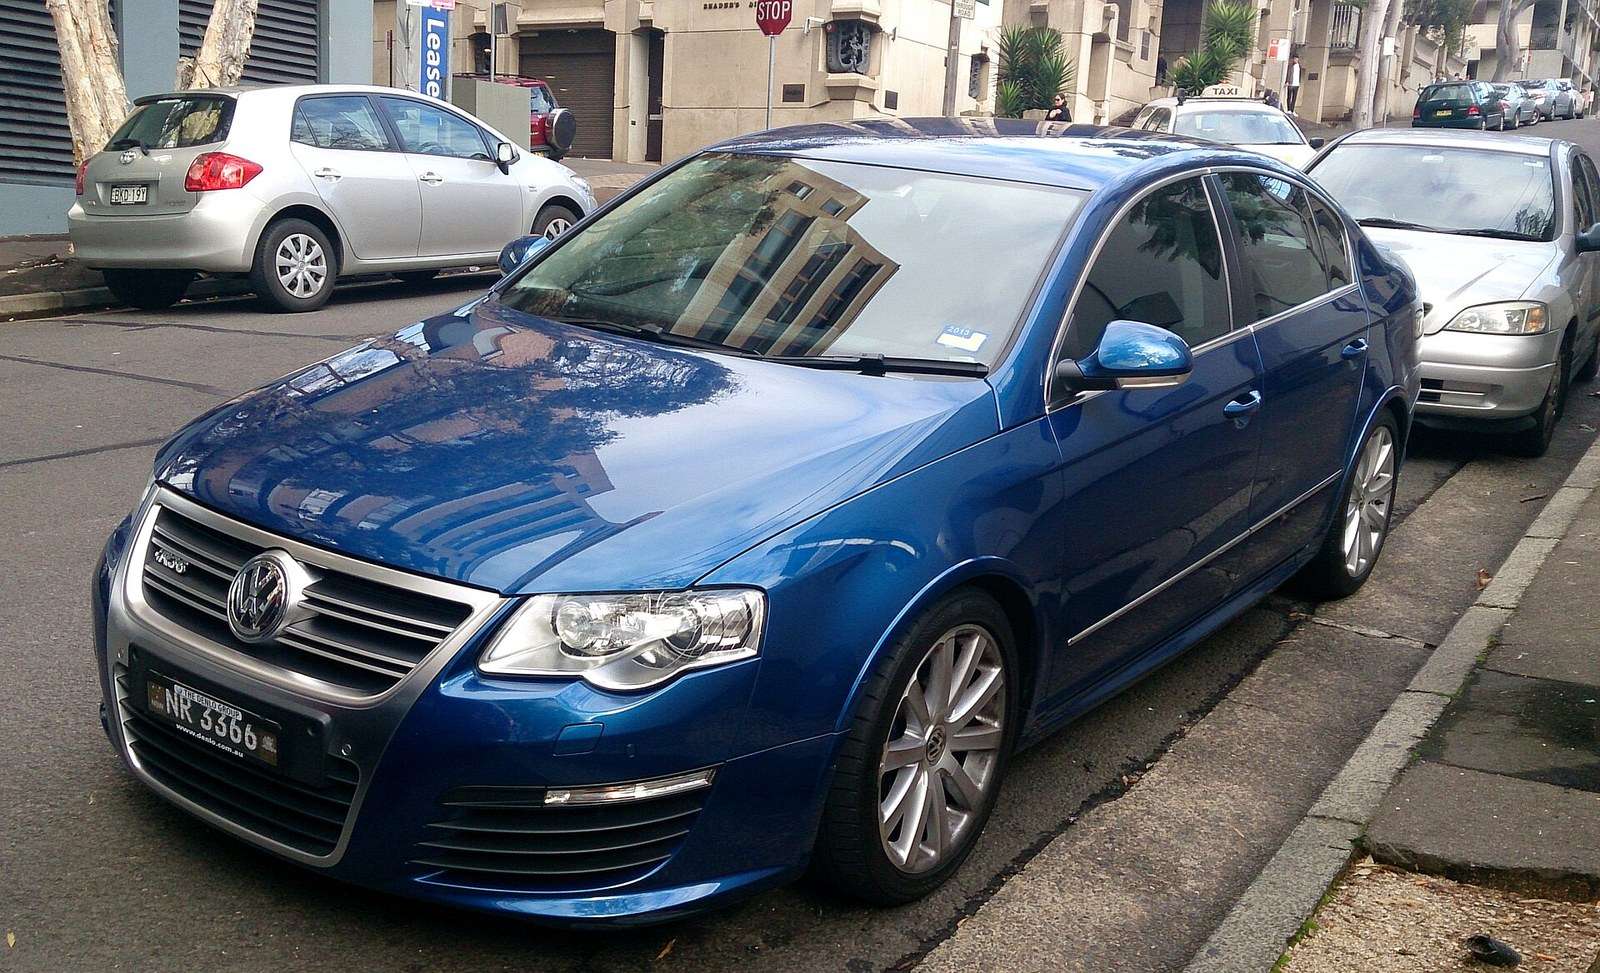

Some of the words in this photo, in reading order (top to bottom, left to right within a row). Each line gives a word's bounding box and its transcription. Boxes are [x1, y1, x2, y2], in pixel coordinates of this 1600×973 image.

[757, 1, 791, 20] STOP
[426, 18, 445, 98] Lease
[1212, 88, 1238, 96] TAXI
[165, 687, 193, 724] NR
[200, 708, 258, 751] 3366
[183, 688, 197, 701] THE
[217, 701, 241, 719] GROUP
